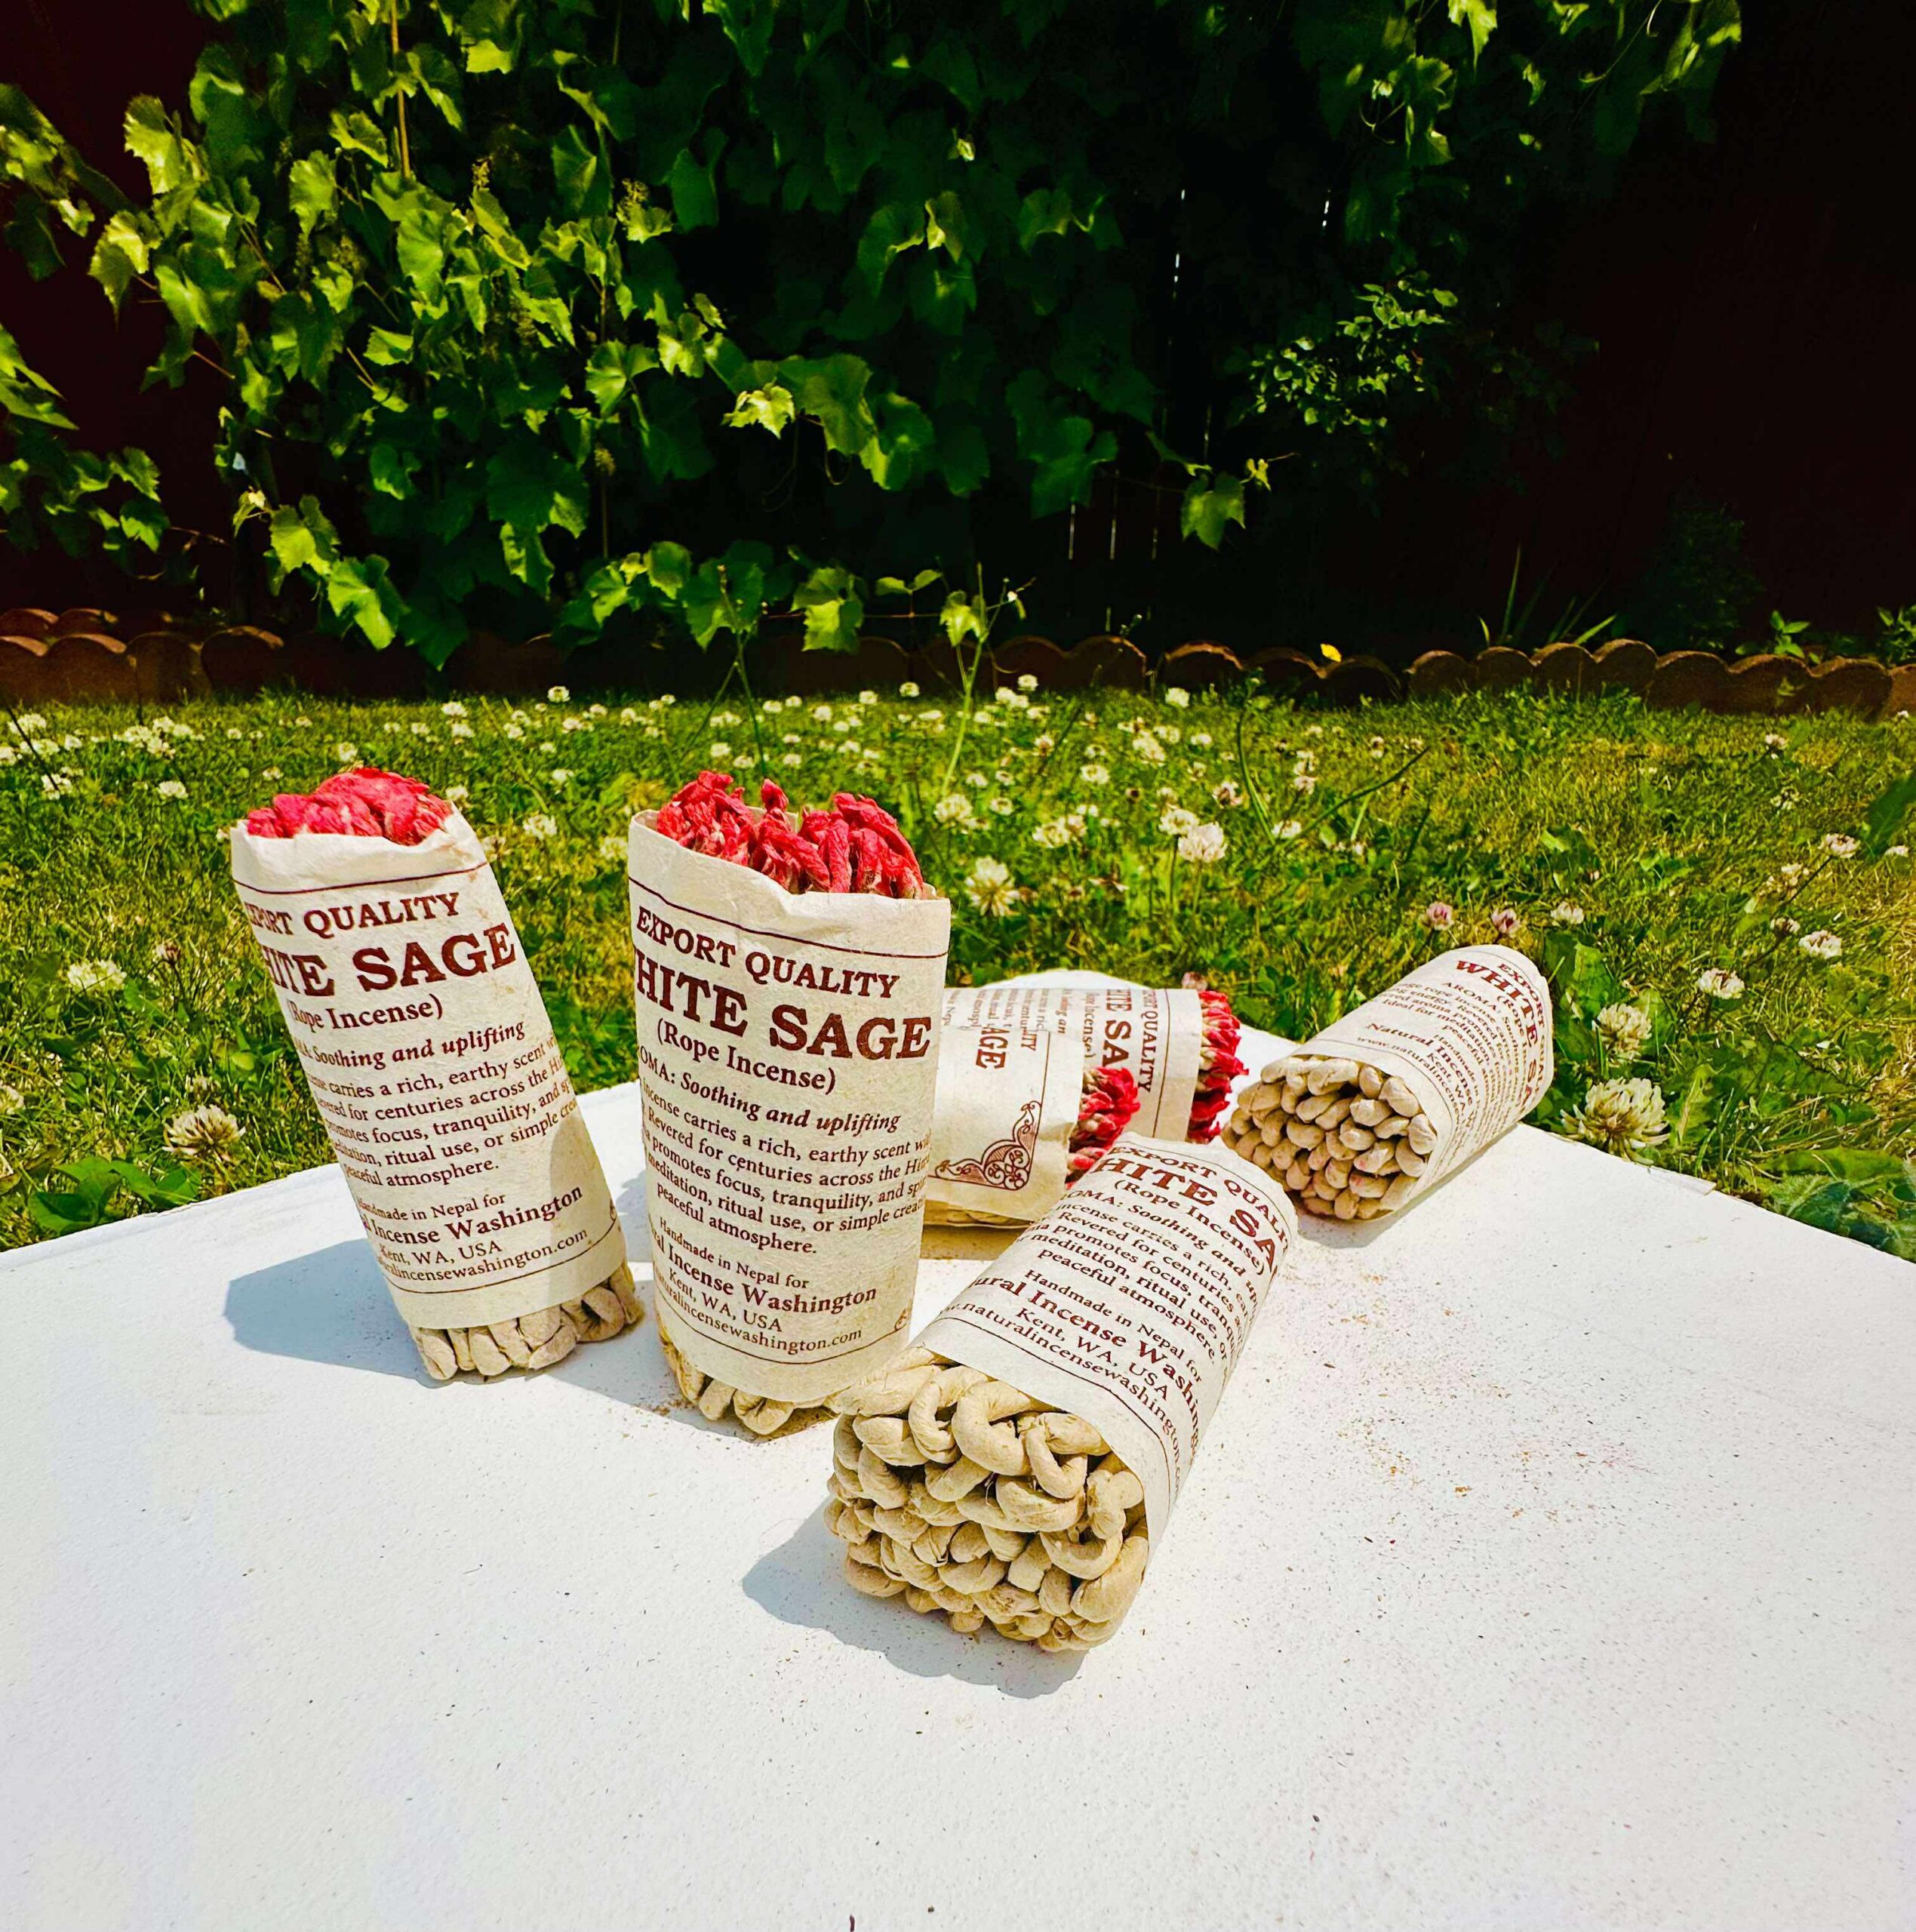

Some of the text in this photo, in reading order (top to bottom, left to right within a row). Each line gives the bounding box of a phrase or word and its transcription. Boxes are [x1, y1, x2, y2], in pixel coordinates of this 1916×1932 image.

[303, 891, 459, 939] QUALITY
[352, 922, 516, 992] SAGE
[636, 906, 900, 998] EXPORT QUALITY
[324, 993, 443, 1029] Incense)
[635, 948, 748, 1037] HITE
[769, 1004, 932, 1060] SAGE
[1456, 960, 1539, 1048] WHITE
[1498, 963, 1545, 1028] EXPORT
[312, 1044, 386, 1070] Soothing
[392, 1038, 434, 1063] and
[441, 1021, 525, 1057] uplifting
[380, 1084, 392, 1096] a
[398, 1073, 444, 1095] rich,
[447, 1058, 508, 1086] earthy
[514, 1043, 546, 1069] scent
[657, 1017, 836, 1095] (Rope Incense)
[976, 1026, 1010, 1069] AGE
[1103, 1020, 1132, 1067] SA
[1137, 1011, 1158, 1093] QUALITY
[1365, 1023, 1434, 1047] Natural
[1435, 1045, 1472, 1106] Incense
[347, 1103, 368, 1121] for
[375, 1095, 463, 1121] centuries
[469, 1080, 525, 1106] across
[527, 1069, 549, 1088] the
[371, 1126, 429, 1143] focus,
[433, 1102, 537, 1137] tranquility,
[538, 1082, 560, 1107] and
[640, 1045, 901, 1137] OMA: Soothing and uplifting
[385, 1145, 436, 1165] ritual
[441, 1140, 479, 1159] use,
[484, 1135, 505, 1149] or
[511, 1112, 558, 1143] simple
[386, 1159, 499, 1186] atmosphere.
[648, 1106, 694, 1149] Revered
[699, 1137, 724, 1160] for
[728, 1153, 813, 1186] centuries
[819, 1171, 874, 1186] across
[878, 1165, 901, 1181] the
[684, 1112, 737, 1142] carries
[742, 1133, 752, 1147] a
[758, 1140, 801, 1160] rich,
[809, 1147, 869, 1169] earthy
[873, 1141, 910, 1161] scent
[1109, 1146, 1216, 1178] EXPORT
[411, 1208, 427, 1220] in
[430, 1200, 478, 1218] Nepal
[483, 1193, 506, 1208] for
[653, 1137, 711, 1179] promotes
[715, 1168, 765, 1201] focus,
[772, 1189, 874, 1214] tranquility,
[878, 1182, 904, 1202] and
[1090, 1158, 1218, 1206] HITE
[371, 1218, 440, 1244] Incense
[444, 1186, 583, 1240] Washington
[657, 1182, 704, 1223] peaceful
[709, 1215, 817, 1254] atmosphere.
[718, 1195, 763, 1223] ritual
[770, 1214, 806, 1233] use,
[813, 1219, 835, 1232] or
[839, 1209, 890, 1232] simple
[1066, 1189, 1247, 1277] OMA: Soothing and
[1114, 1180, 1265, 1275] (Rope Incense)
[411, 1251, 455, 1266] WA,
[457, 1239, 502, 1260] USA
[660, 1216, 715, 1263] Handmade
[718, 1255, 730, 1270] in
[736, 1260, 780, 1285] Nepal
[786, 1274, 810, 1289] for
[669, 1242, 877, 1315] Incense Washington
[1031, 1233, 1130, 1279] meditation,
[1136, 1276, 1186, 1309] ritual
[1190, 1309, 1217, 1340] use,
[1052, 1224, 1192, 1297] promotes focus,
[1057, 1211, 1130, 1241] Revered
[1131, 1238, 1159, 1256] for
[1162, 1255, 1234, 1313] centuries
[1122, 1220, 1180, 1251] carries
[1183, 1251, 1192, 1260] a
[1198, 1260, 1232, 1291] rich,
[669, 1267, 783, 1332] Kent, WA, USA
[1025, 1269, 1112, 1317] Handmade
[1115, 1313, 1133, 1327] in
[1136, 1323, 1185, 1360] Nepal
[1186, 1358, 1202, 1383] for
[1027, 1289, 1127, 1347] Incense
[1038, 1249, 1116, 1287] peaceful
[1118, 1285, 1215, 1364] atmosphere.
[1016, 1307, 1169, 1401] Kent, WA, USA
